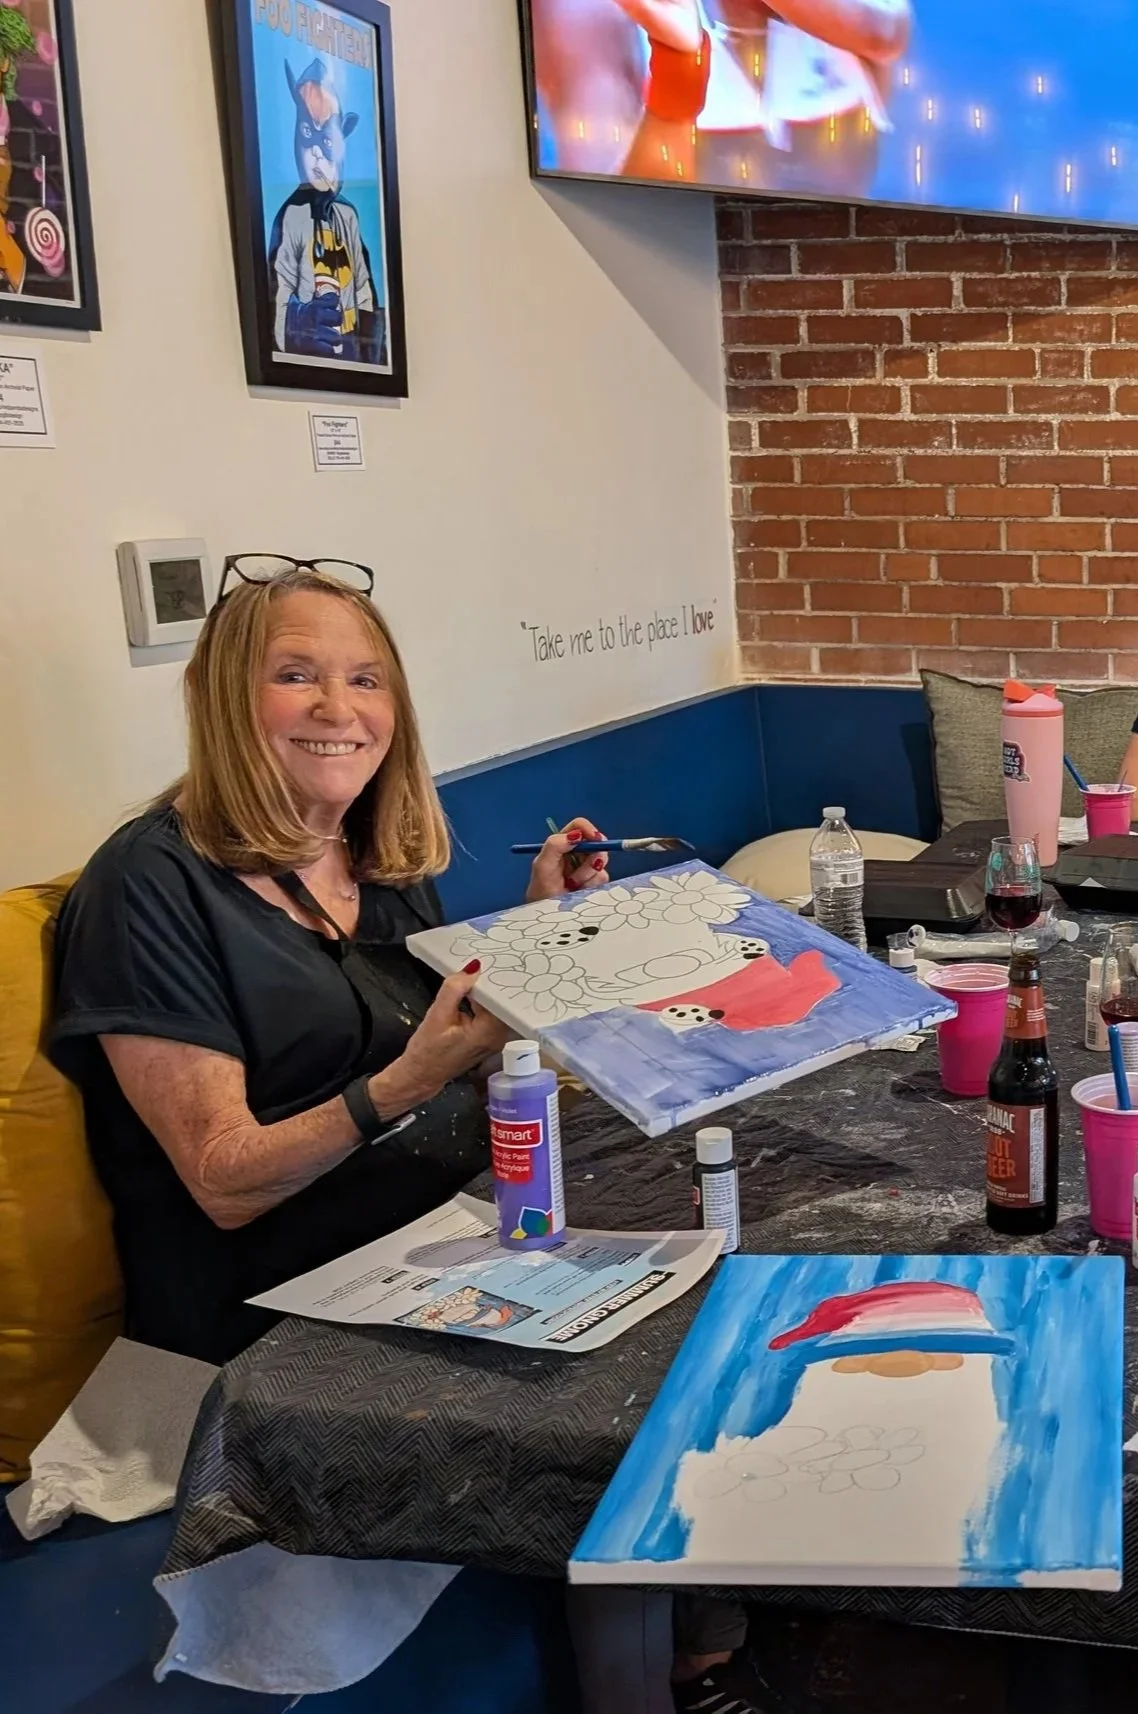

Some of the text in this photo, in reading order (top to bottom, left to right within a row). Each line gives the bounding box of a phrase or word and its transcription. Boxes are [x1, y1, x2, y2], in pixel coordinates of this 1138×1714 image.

[570, 629, 594, 656] me
[598, 617, 615, 650] to
[619, 614, 643, 648] the
[648, 610, 678, 651] place
[682, 605, 688, 635] I
[512, 1153, 530, 1161] Paint
[603, 1273, 666, 1311] SUMMER
[552, 1309, 609, 1342] GNOME
